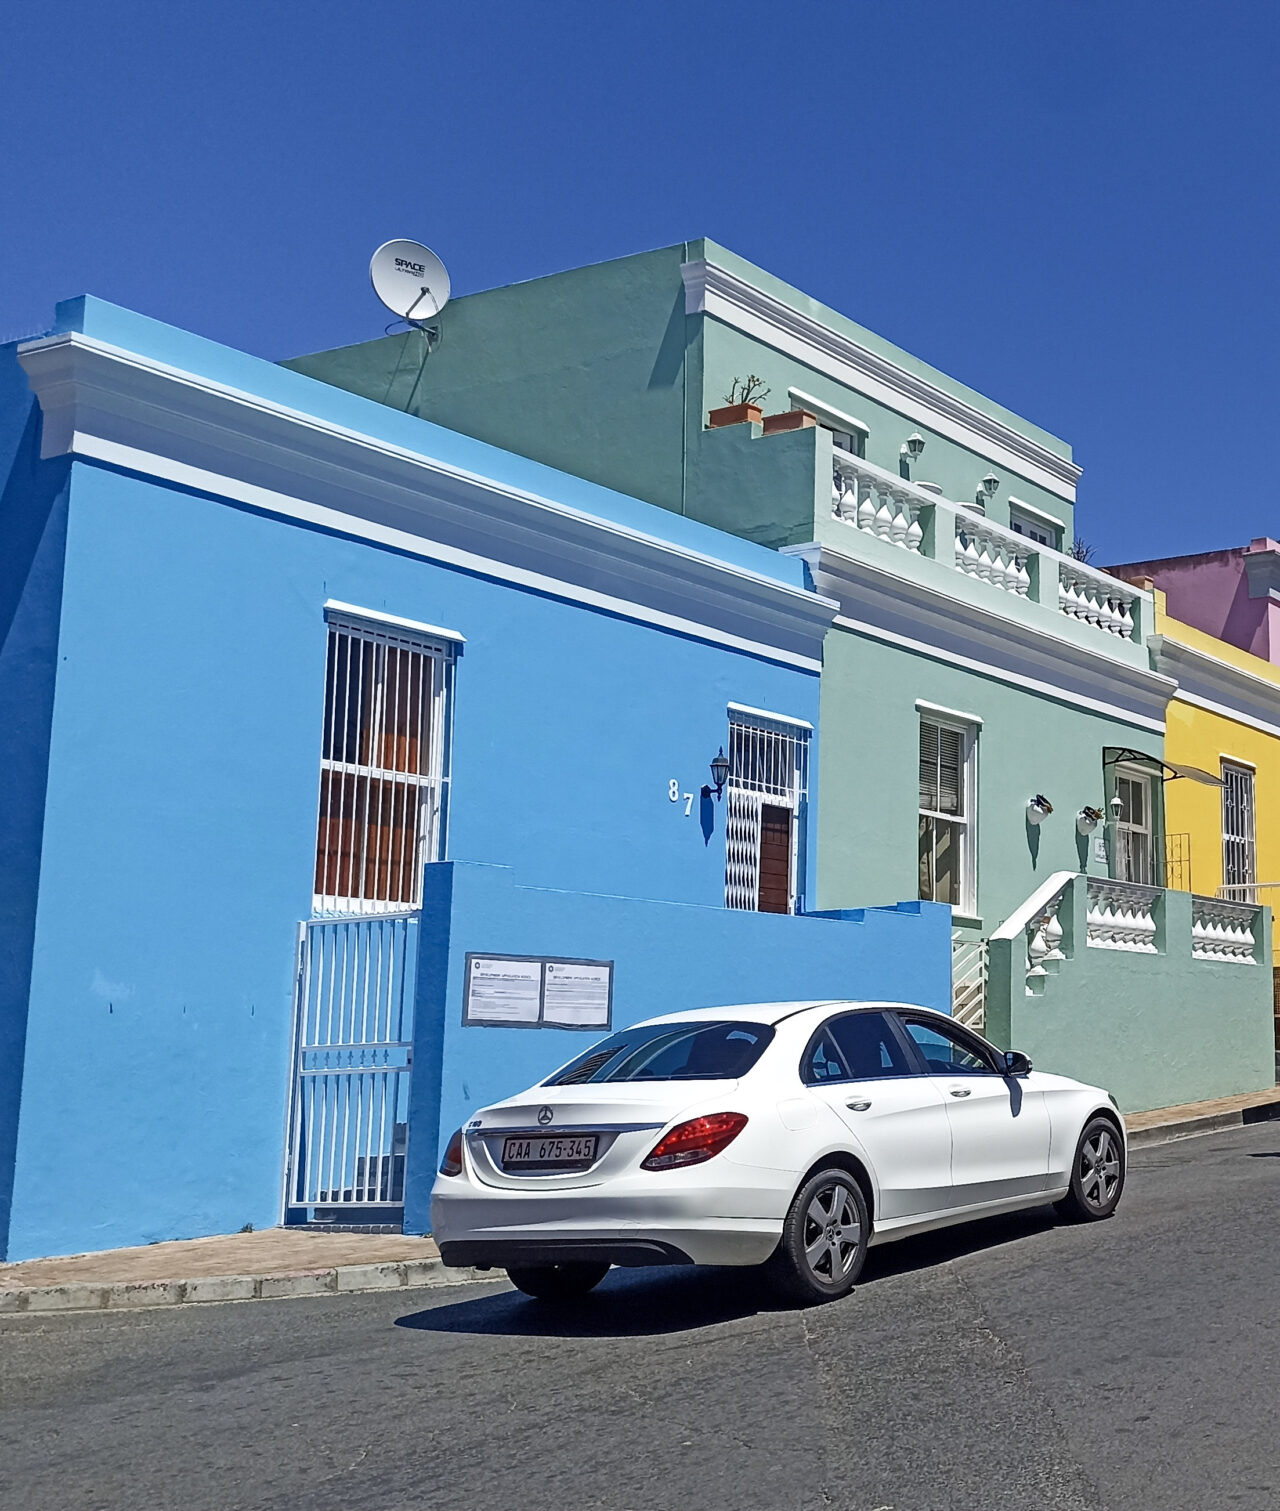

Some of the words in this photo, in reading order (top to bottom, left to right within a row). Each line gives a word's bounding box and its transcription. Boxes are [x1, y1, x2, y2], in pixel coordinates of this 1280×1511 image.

[394, 257, 426, 273] SPACE
[669, 779, 694, 816] 87
[508, 1142, 531, 1159] CAA
[540, 1140, 592, 1158] 675-345
